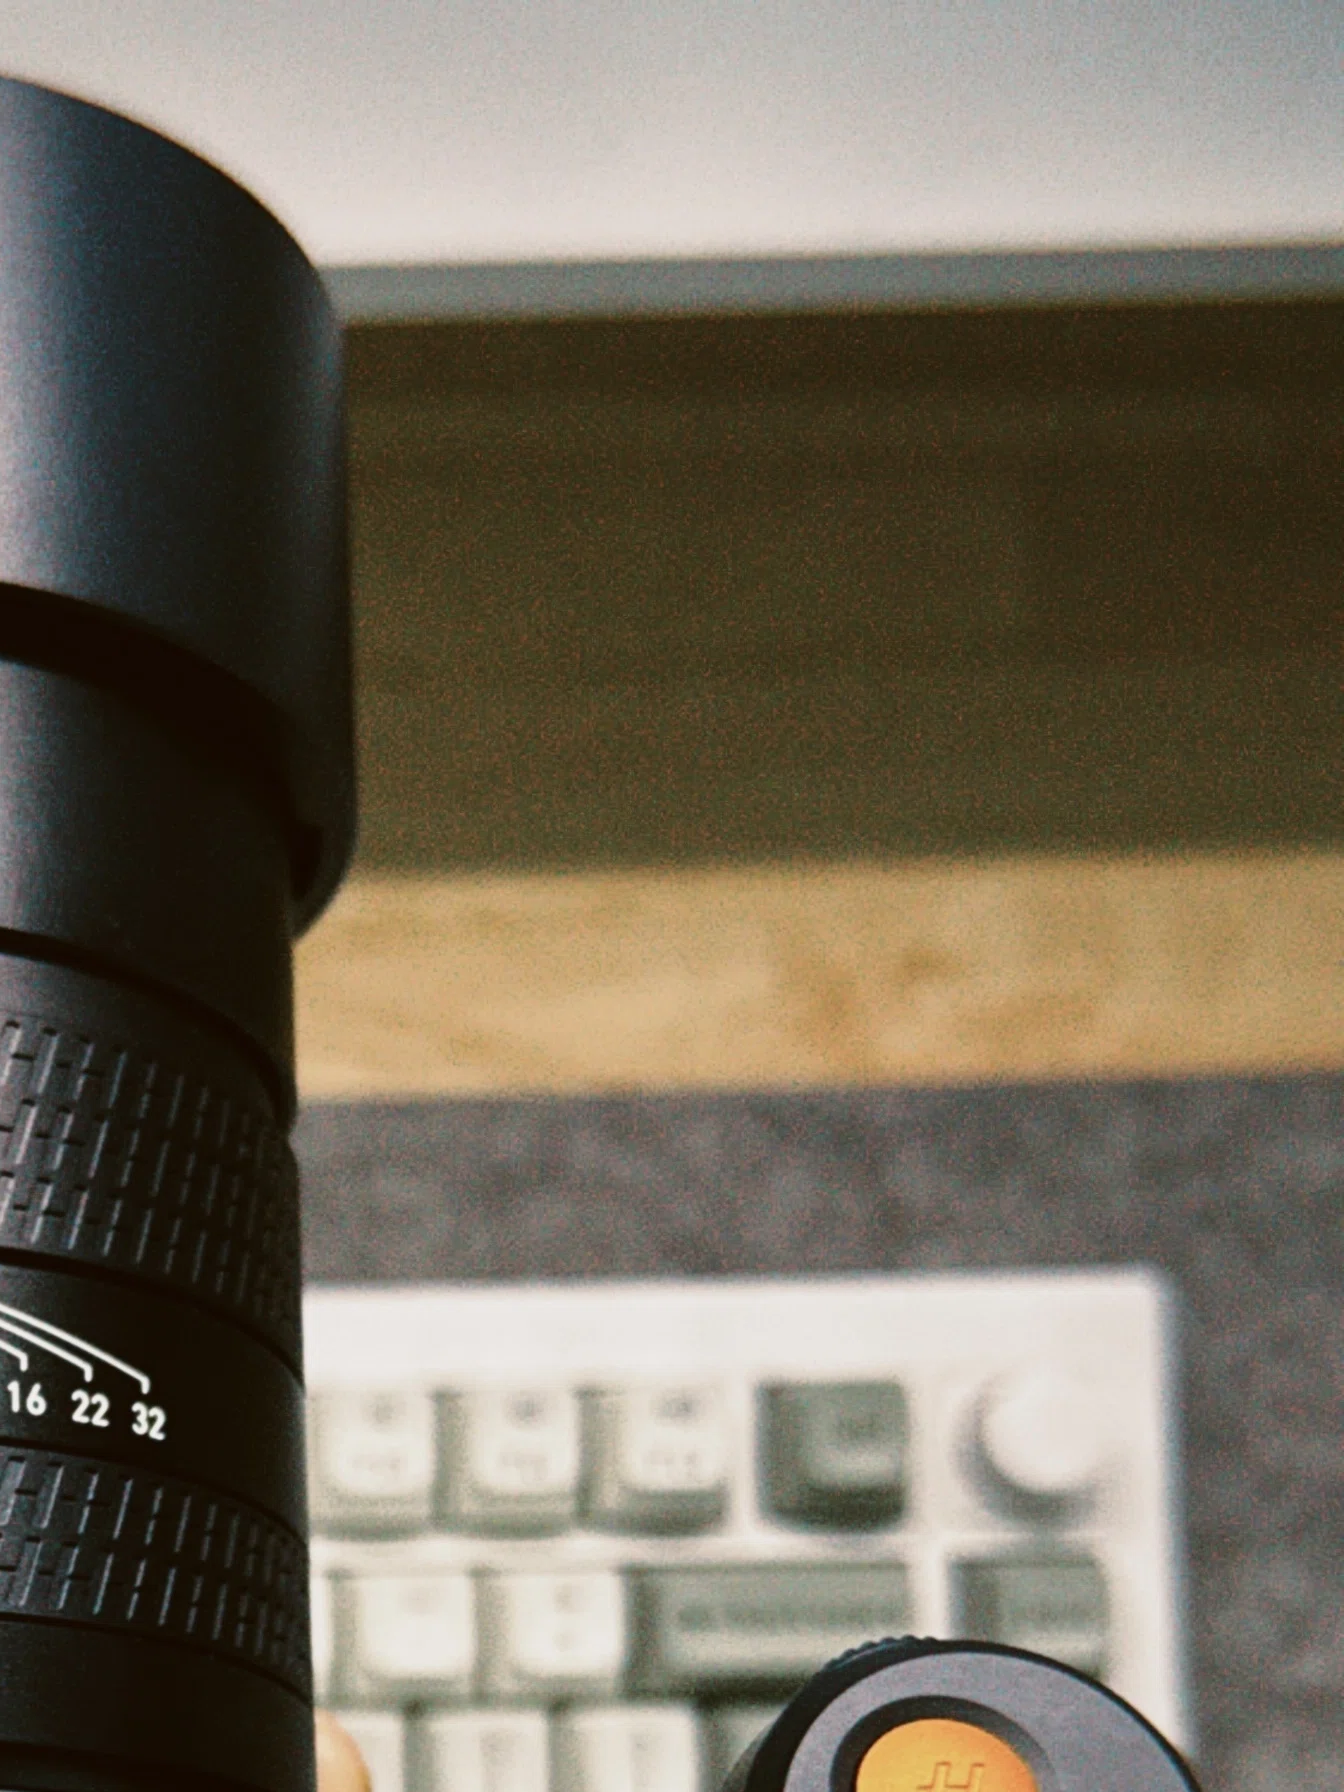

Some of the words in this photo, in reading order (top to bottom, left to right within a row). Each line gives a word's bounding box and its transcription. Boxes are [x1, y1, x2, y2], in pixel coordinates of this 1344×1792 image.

[7, 1379, 47, 1416] 16
[70, 1388, 110, 1429] 22
[131, 1402, 167, 1441] 32
